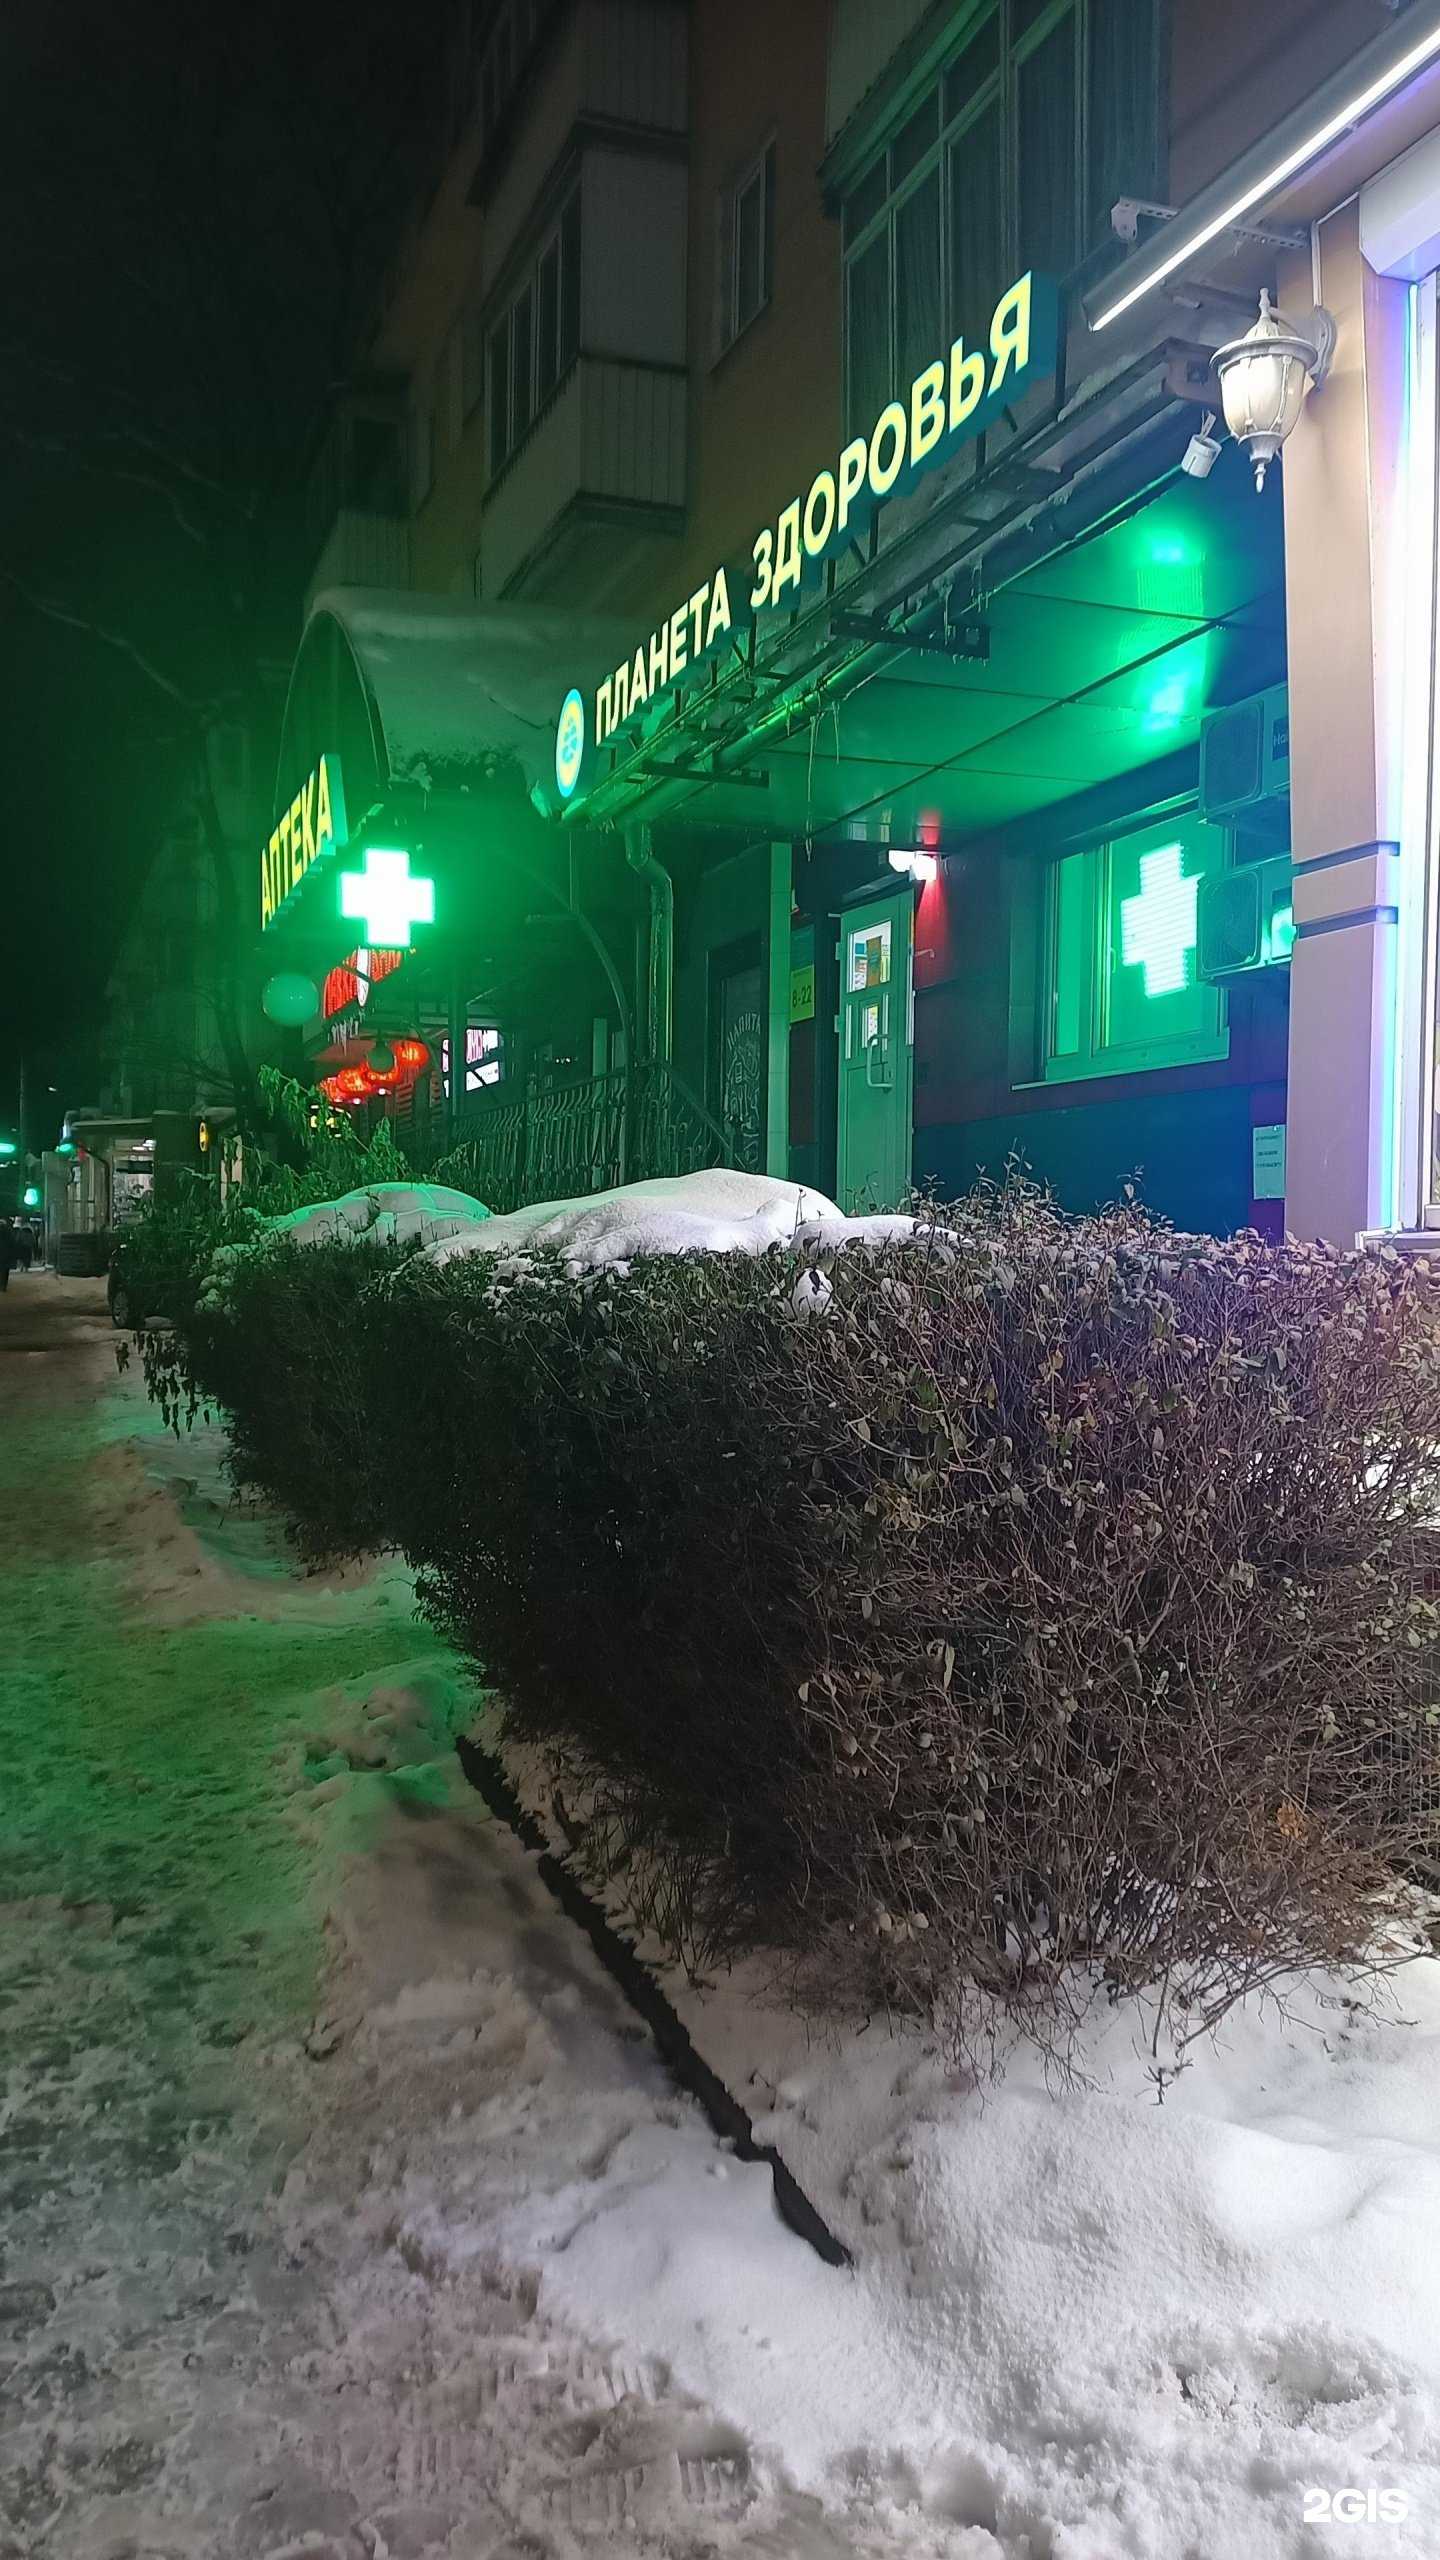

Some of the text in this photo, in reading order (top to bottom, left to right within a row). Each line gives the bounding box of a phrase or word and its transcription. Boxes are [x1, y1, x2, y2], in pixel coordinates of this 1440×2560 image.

[595, 270, 1032, 746] ПЛАНЕТА ЗДОРОВЬЯ
[262, 753, 333, 932] АПТЕКА
[792, 985, 812, 1008] 8-22
